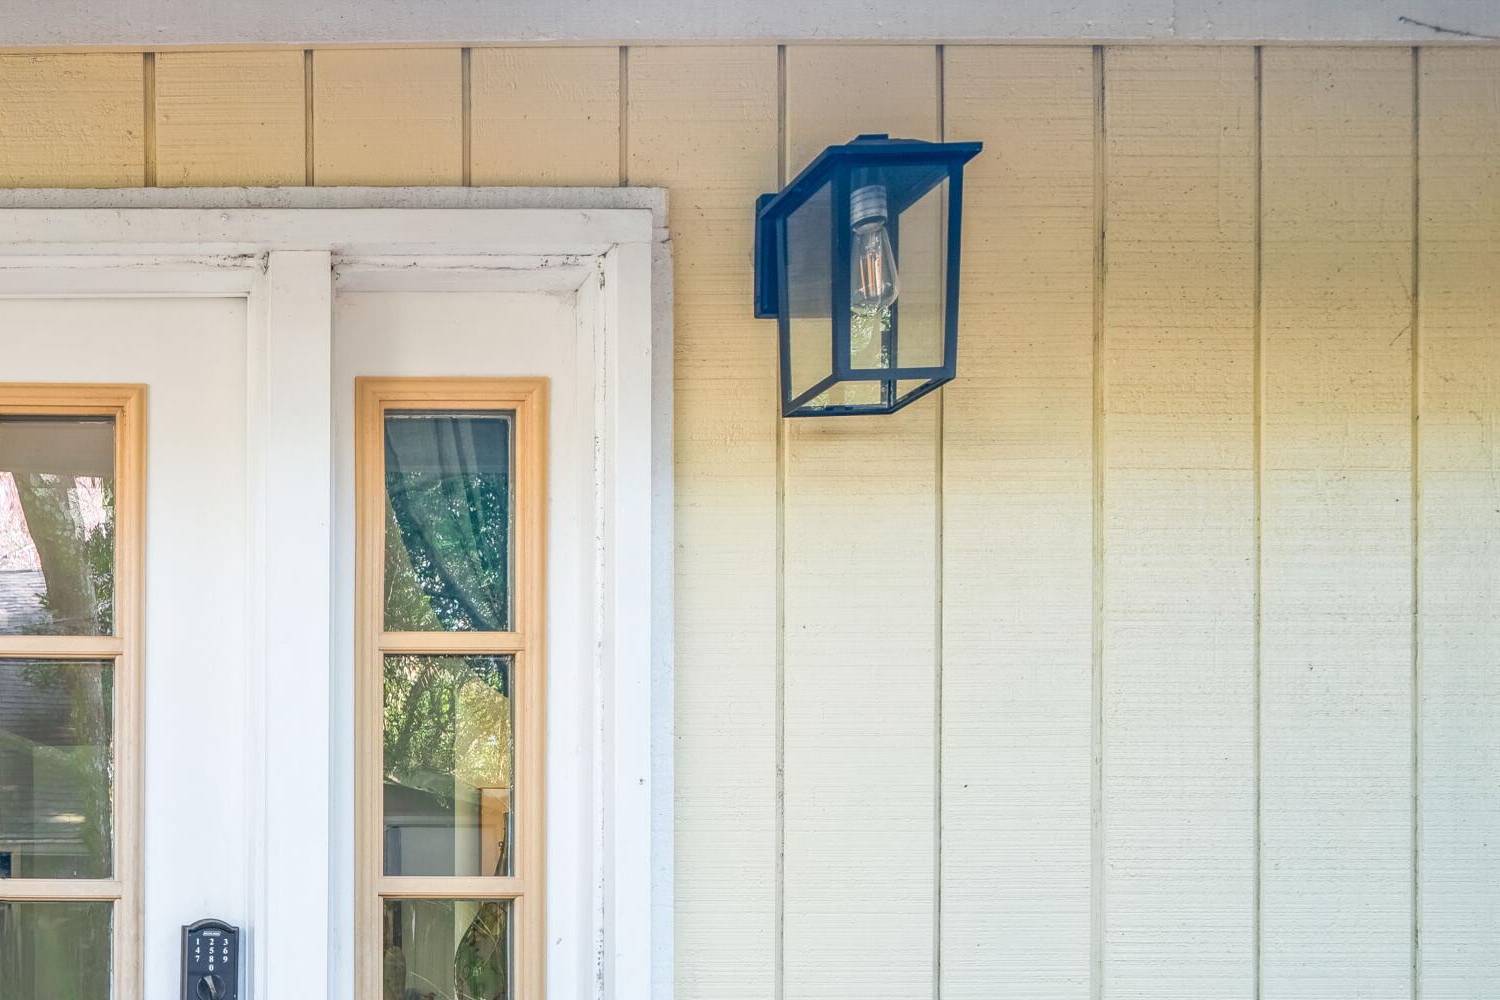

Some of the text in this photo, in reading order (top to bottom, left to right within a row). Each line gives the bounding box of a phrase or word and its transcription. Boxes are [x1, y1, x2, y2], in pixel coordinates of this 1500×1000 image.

[209, 938, 214, 946] 2
[223, 938, 229, 946] 3
[195, 946, 228, 954] 4 5 6
[195, 955, 228, 963] 7 8 9
